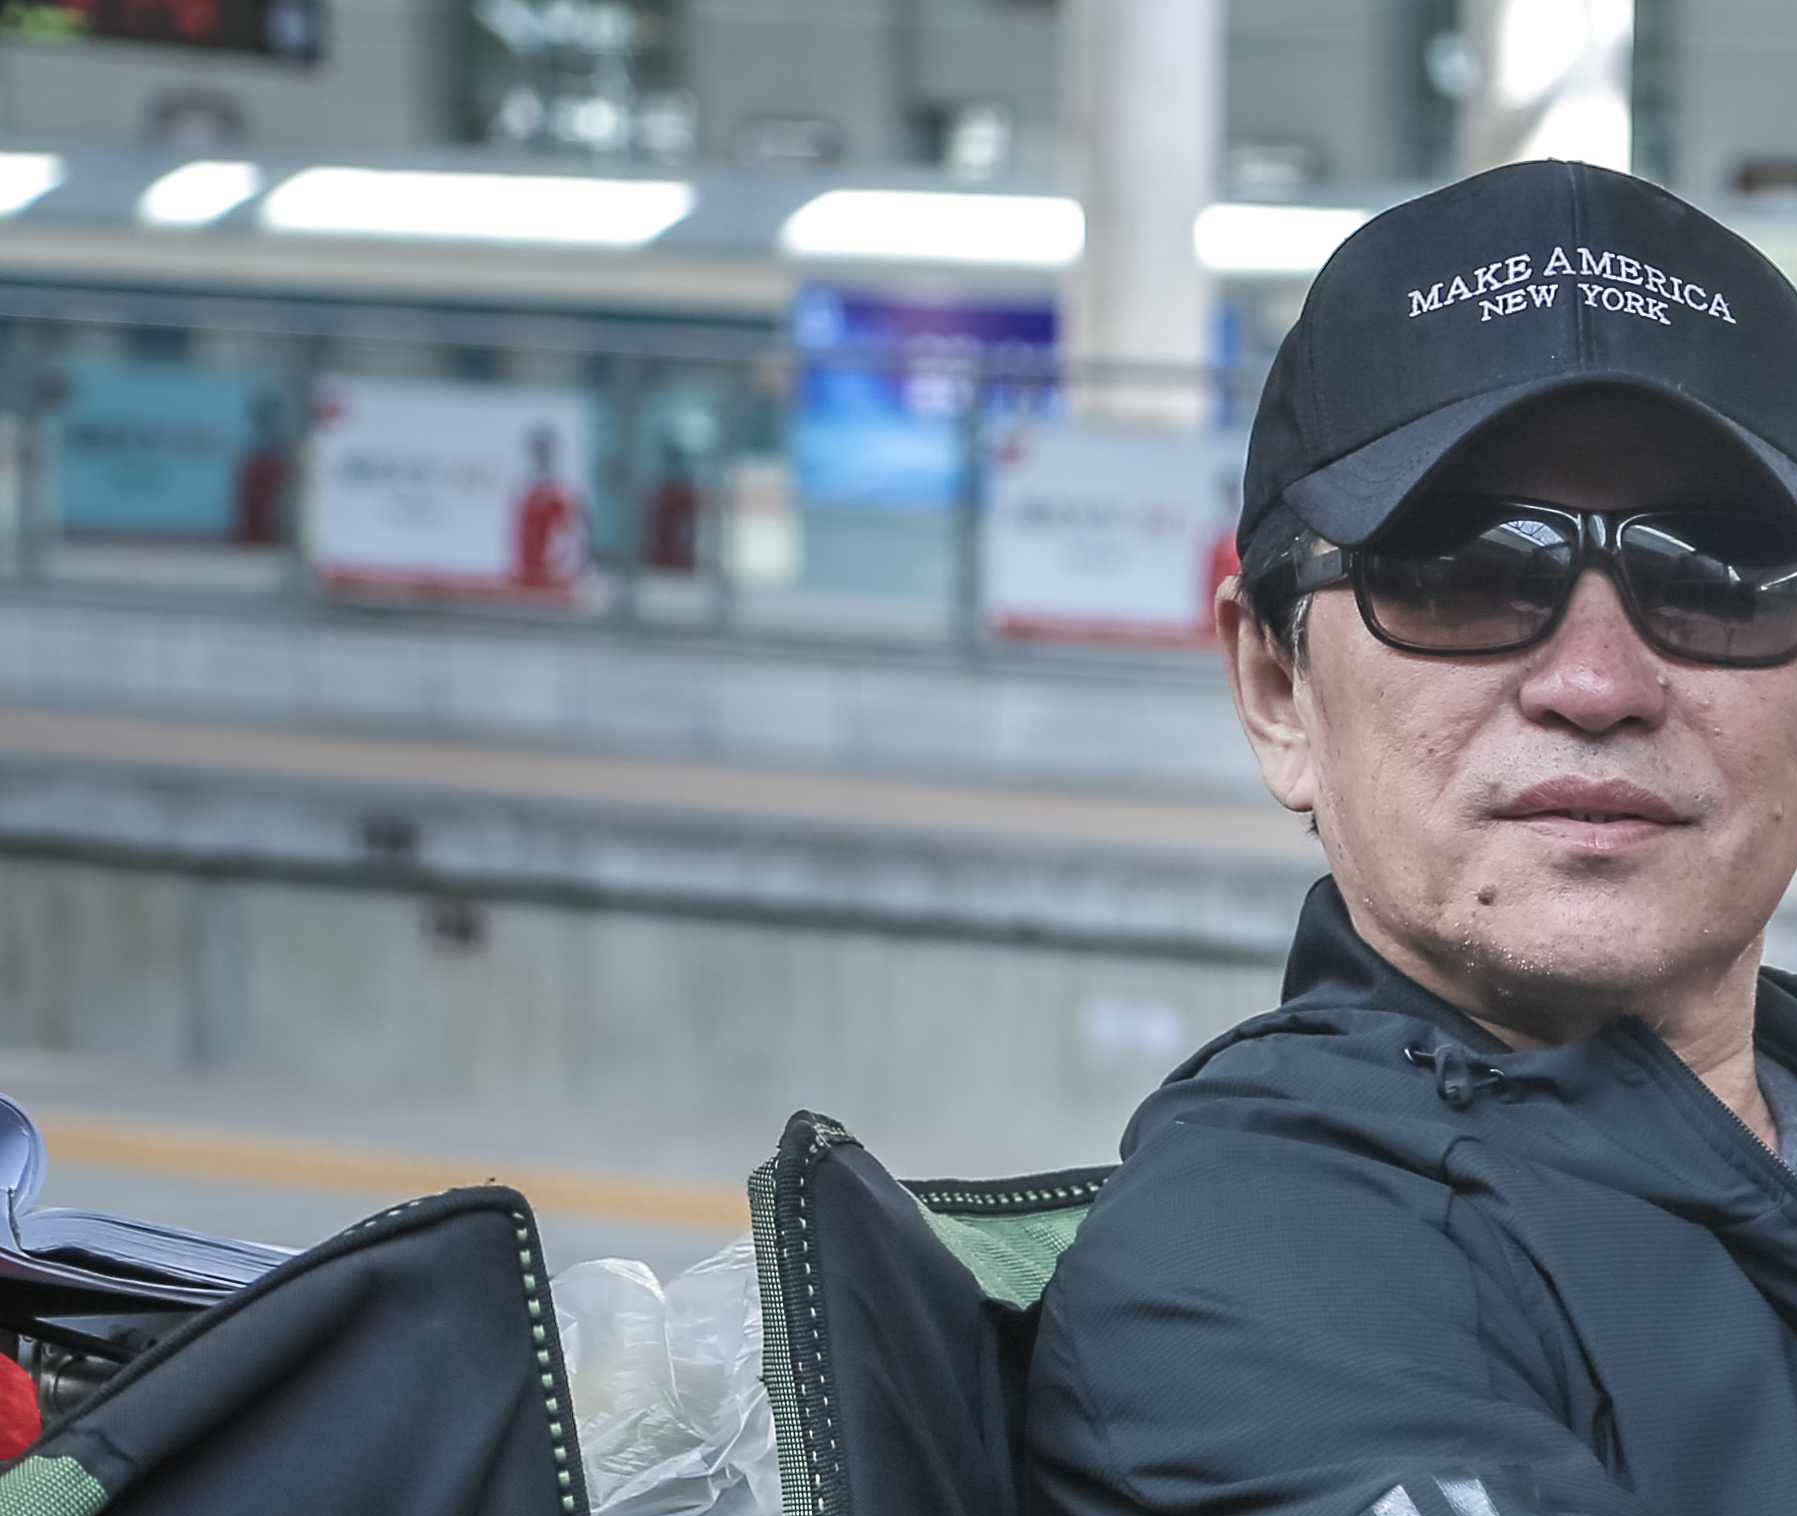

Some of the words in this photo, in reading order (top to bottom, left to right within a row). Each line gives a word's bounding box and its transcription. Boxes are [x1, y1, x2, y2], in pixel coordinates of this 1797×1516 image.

[1407, 253, 1533, 318] MAKE
[1542, 246, 1737, 324] AMERICA
[1478, 283, 1559, 322] NEW
[1576, 282, 1672, 325] YORK
